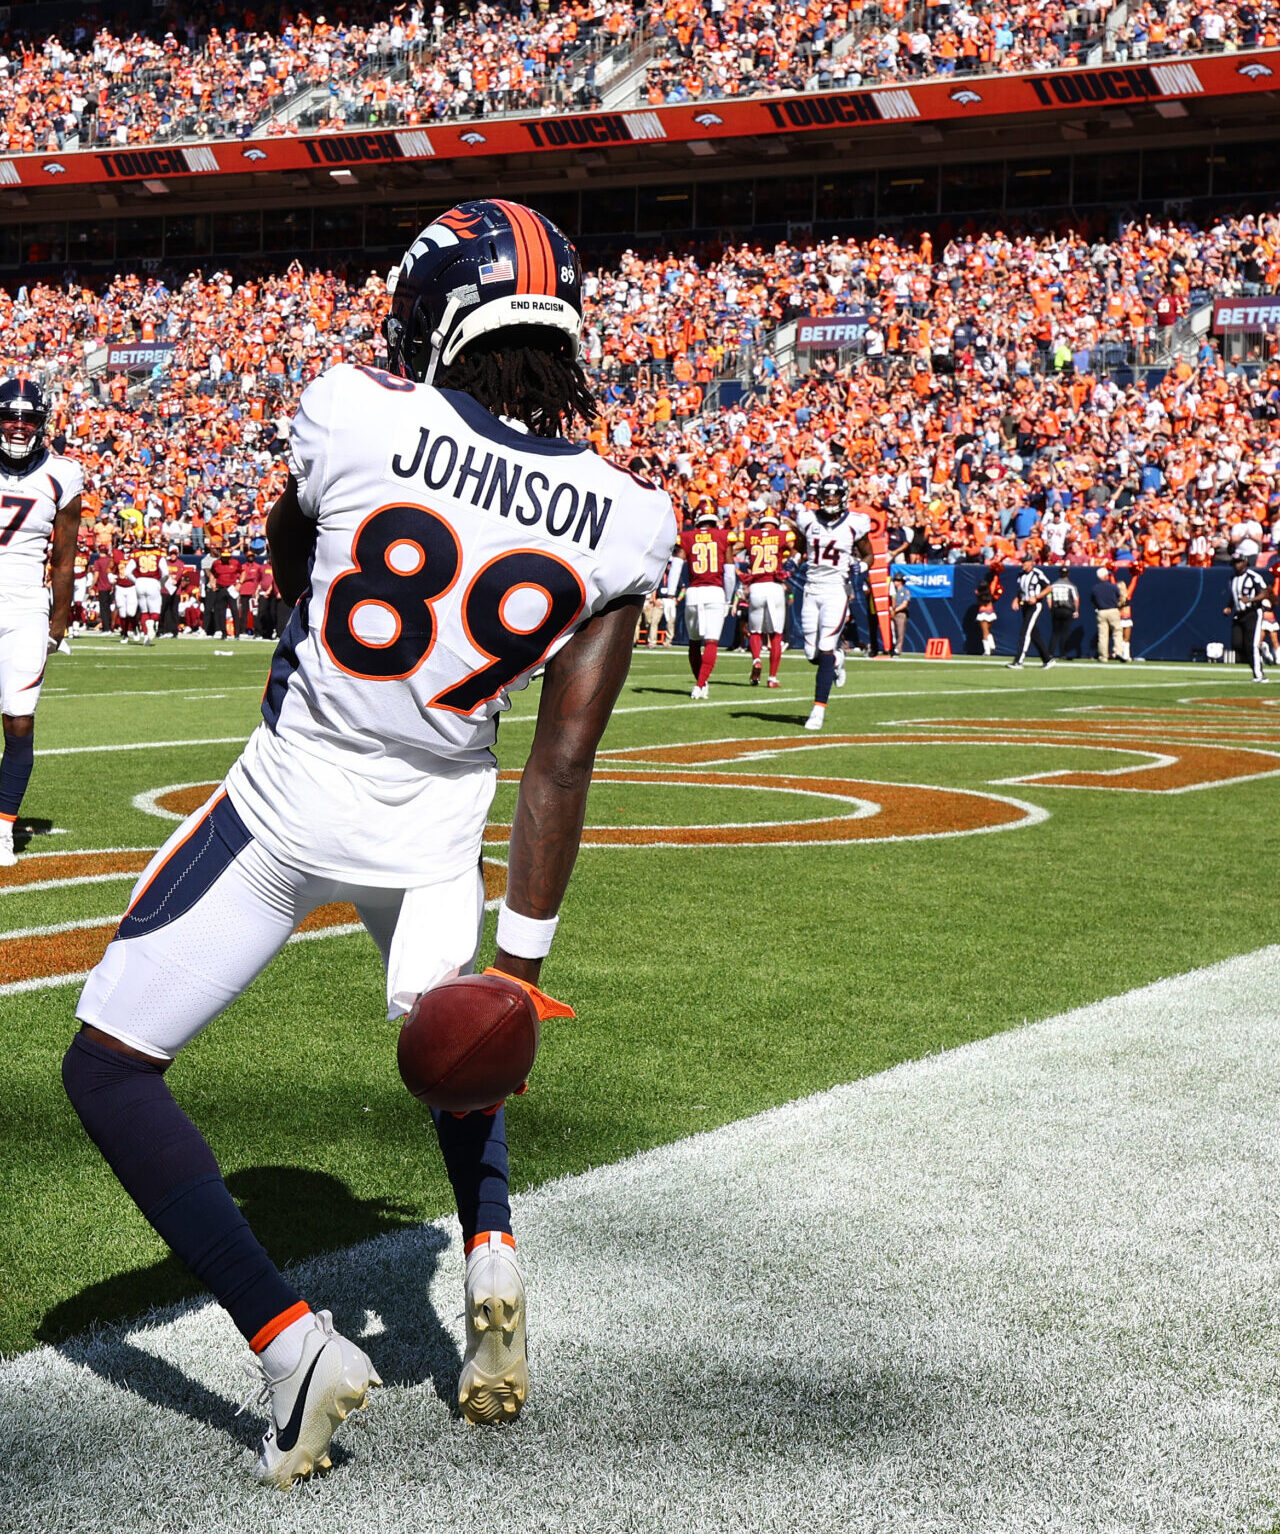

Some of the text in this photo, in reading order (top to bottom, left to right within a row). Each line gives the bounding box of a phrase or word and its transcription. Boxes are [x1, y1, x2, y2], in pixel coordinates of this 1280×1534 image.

[1023, 63, 1204, 105] TOUCHDOWN
[560, 266, 575, 284] 89
[510, 301, 564, 312] END RACISM
[800, 324, 869, 342] BETFRE
[391, 426, 613, 551] JOHNSON
[692, 542, 718, 574] 31
[751, 545, 778, 574] 25
[813, 538, 840, 566] 14
[928, 575, 951, 585] NFL
[321, 502, 586, 716] 89
[930, 641, 944, 656] 10
